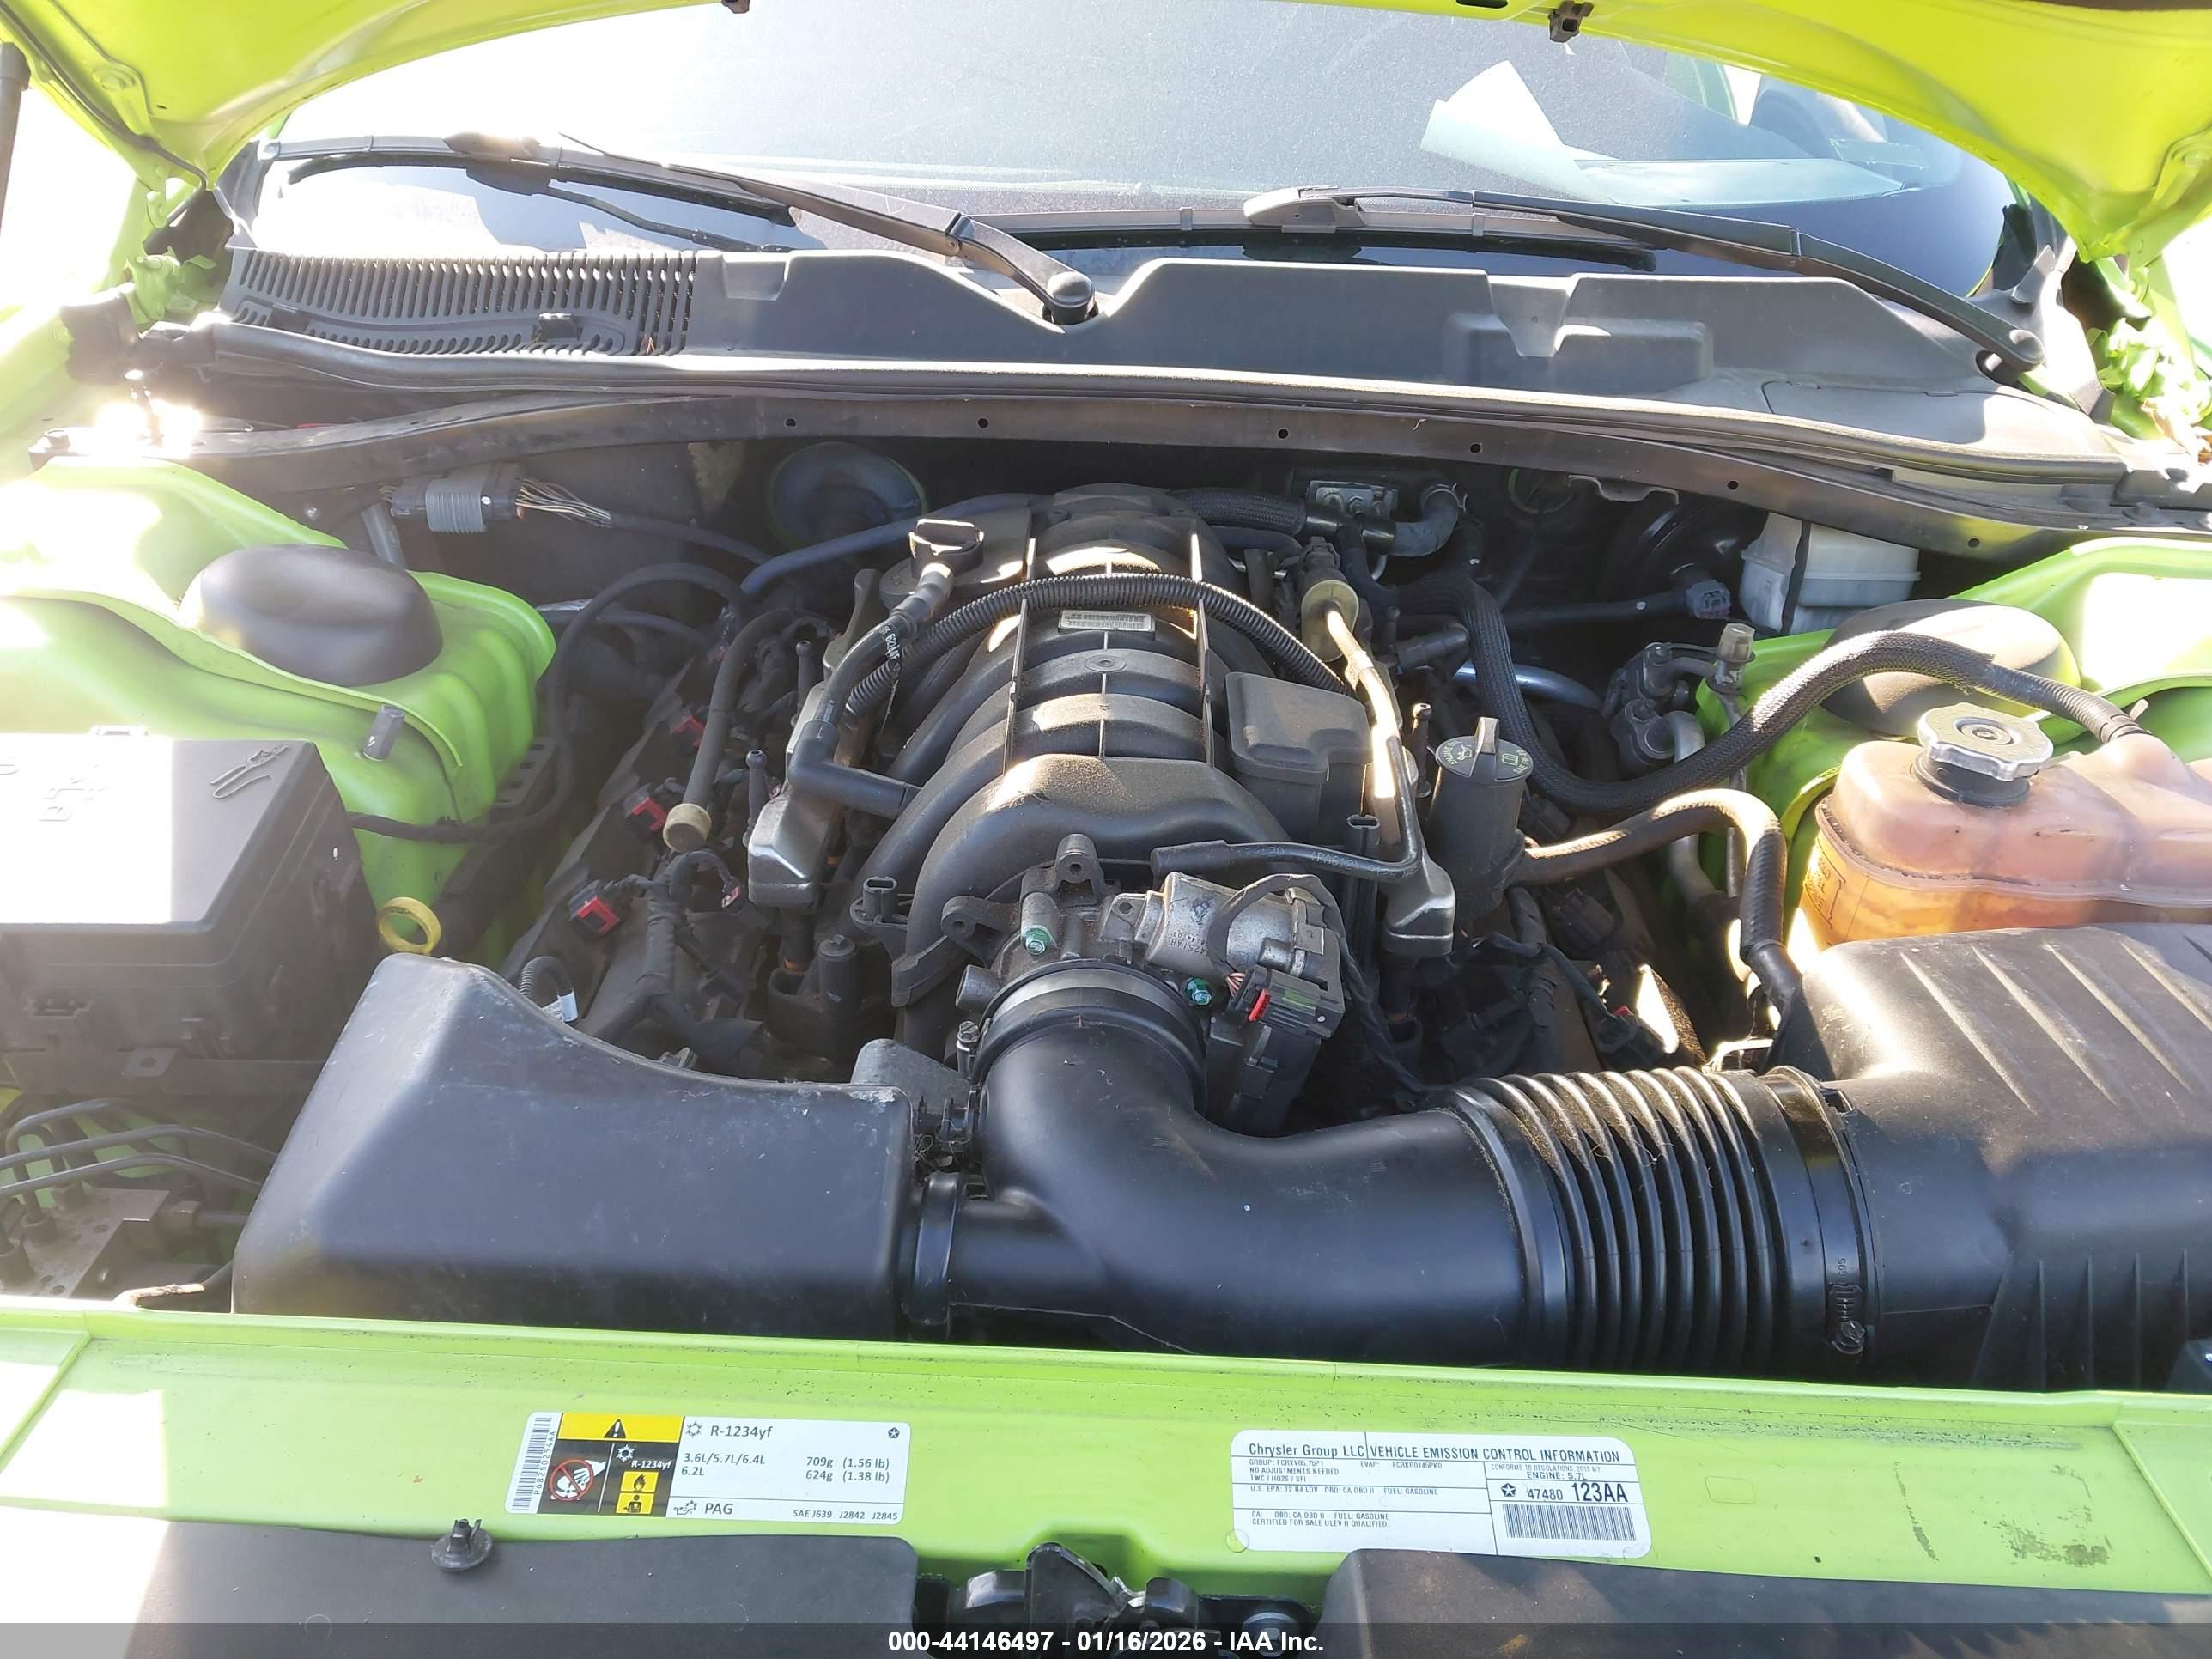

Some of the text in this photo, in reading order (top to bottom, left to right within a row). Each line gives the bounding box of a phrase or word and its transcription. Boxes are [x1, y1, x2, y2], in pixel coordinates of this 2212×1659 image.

[710, 1425, 773, 1440] R-1234yf
[1249, 1443, 1364, 1459] Chrysler Group LLC
[1370, 1446, 1620, 1462] VEHICLE EMISSION CONTROL INFORMATION
[630, 1460, 672, 1471] R-1234yf
[684, 1453, 890, 1470] 3.6L/5.7L/6.4L 709g (1.56 lb)
[681, 1467, 890, 1484] 6.2L 624g (1.38 lb)
[1527, 1471, 1588, 1480] ENGINE: 5.7L
[1528, 1482, 1629, 1503] 47480 123AA
[704, 1503, 898, 1521] PAG SAE J639 J2842 J2845
